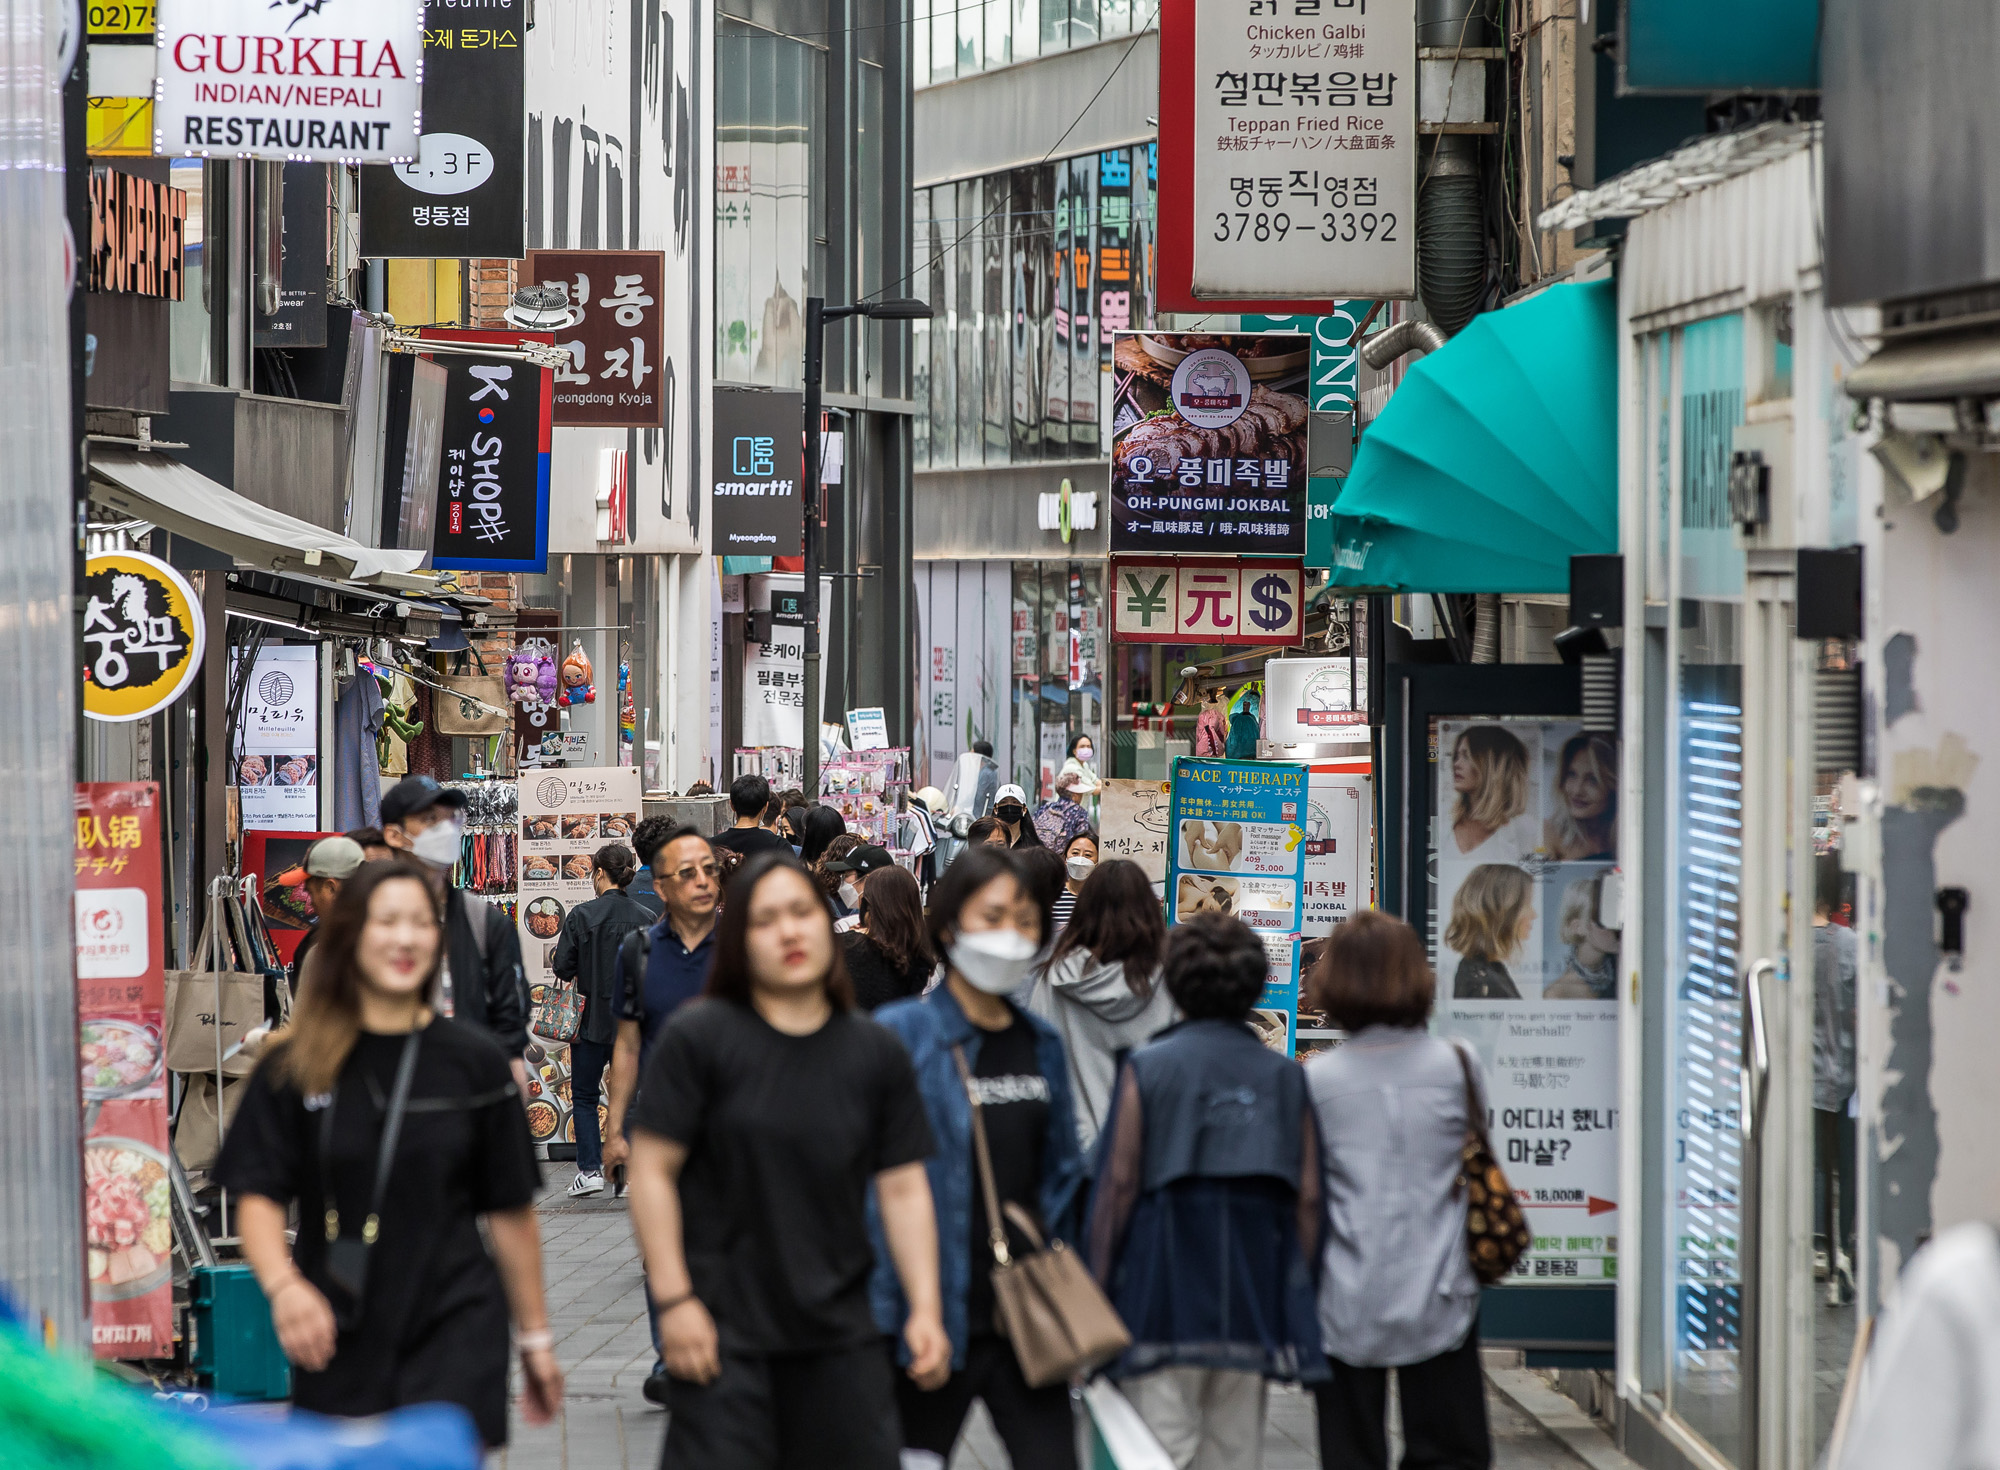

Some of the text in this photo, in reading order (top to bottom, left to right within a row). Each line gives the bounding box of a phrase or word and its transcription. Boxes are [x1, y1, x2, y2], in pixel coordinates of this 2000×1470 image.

[89, 5, 156, 30] 02)7
[460, 29, 517, 49] 돈가스
[1246, 24, 1366, 40] Chicken Galbi
[173, 33, 406, 80] GURKHA
[194, 83, 382, 109] INDIAN/NEPALI
[1214, 70, 1399, 107] 철판볶음밥
[184, 116, 391, 150] RESTAURANT
[1227, 116, 1384, 134] Teppan Fried Rice
[1230, 170, 1378, 208] 명동직영점
[412, 206, 470, 226] 명동점
[1213, 212, 1397, 242] 3789-3392
[469, 365, 512, 401] K
[618, 393, 653, 405] Kyoja
[1127, 455, 1291, 488] 오-풍미족발
[714, 480, 793, 496] smartti
[1127, 496, 1223, 511] OH-PUNGMI
[1227, 499, 1290, 512] JOKBAL
[451, 504, 461, 532] 2019
[729, 533, 777, 543] Myeongdong
[759, 643, 805, 661] 폰케이
[757, 670, 805, 689] 필름부
[1191, 770, 1303, 786] ACE THERAPY
[1218, 785, 1262, 795] マッサージ
[1275, 788, 1302, 797] エステ
[73, 815, 142, 849] 队锅
[1104, 838, 1143, 854] 제임스
[1255, 864, 1284, 872] 25,000
[1252, 918, 1281, 926] 25,000
[1453, 1012, 1484, 1021] Where
[1489, 1012, 1504, 1021] did
[1509, 1013, 1526, 1022] you
[1550, 1013, 1572, 1022] your
[1510, 1026, 1572, 1037] Marshall?
[1503, 1108, 1564, 1129] 어디서
[1535, 1261, 1578, 1276] 명동점
